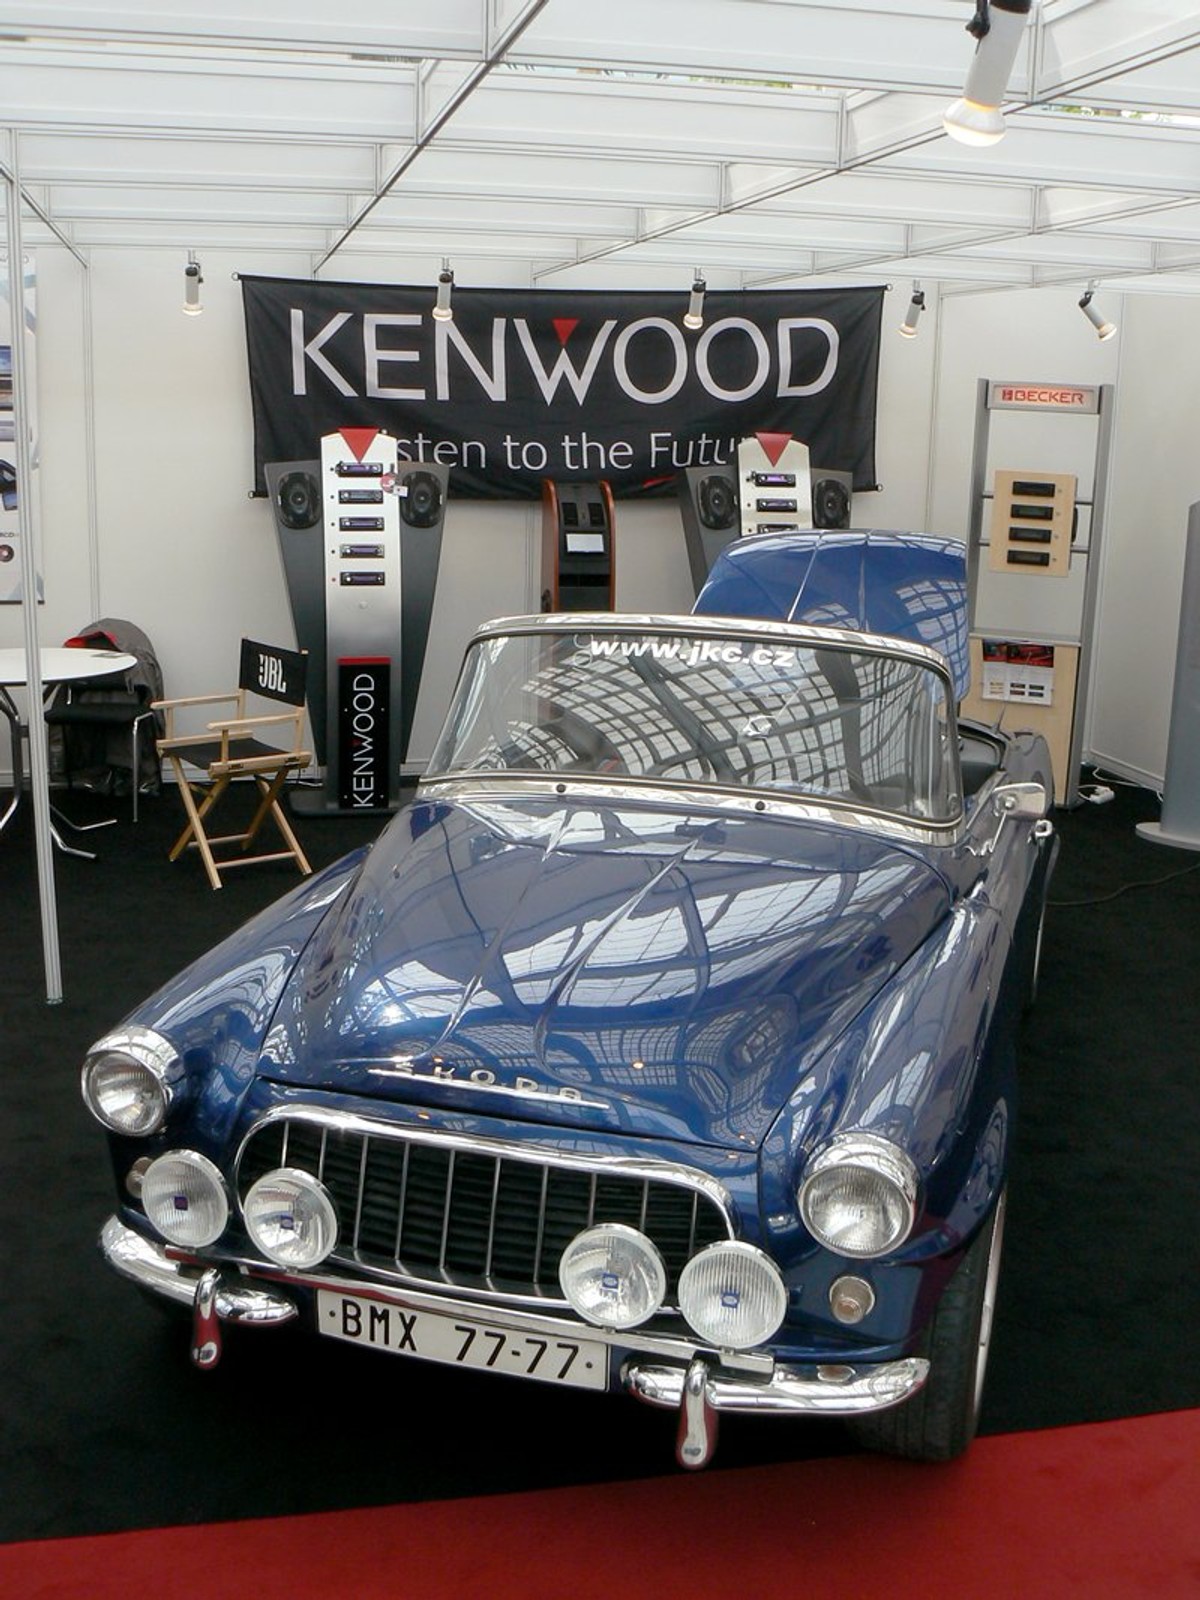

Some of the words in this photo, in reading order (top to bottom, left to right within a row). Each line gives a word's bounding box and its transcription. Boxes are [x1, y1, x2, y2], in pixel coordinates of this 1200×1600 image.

[290, 308, 840, 407] KENWOOD
[1013, 389, 1085, 405] BECKER
[502, 434, 548, 471] to
[561, 431, 634, 470] the
[258, 653, 287, 693] JBL
[589, 639, 796, 668] www.jkc.cz
[352, 673, 375, 808] KENWOOD
[341, 1298, 418, 1352] BMX
[454, 1324, 580, 1380] 77-77
